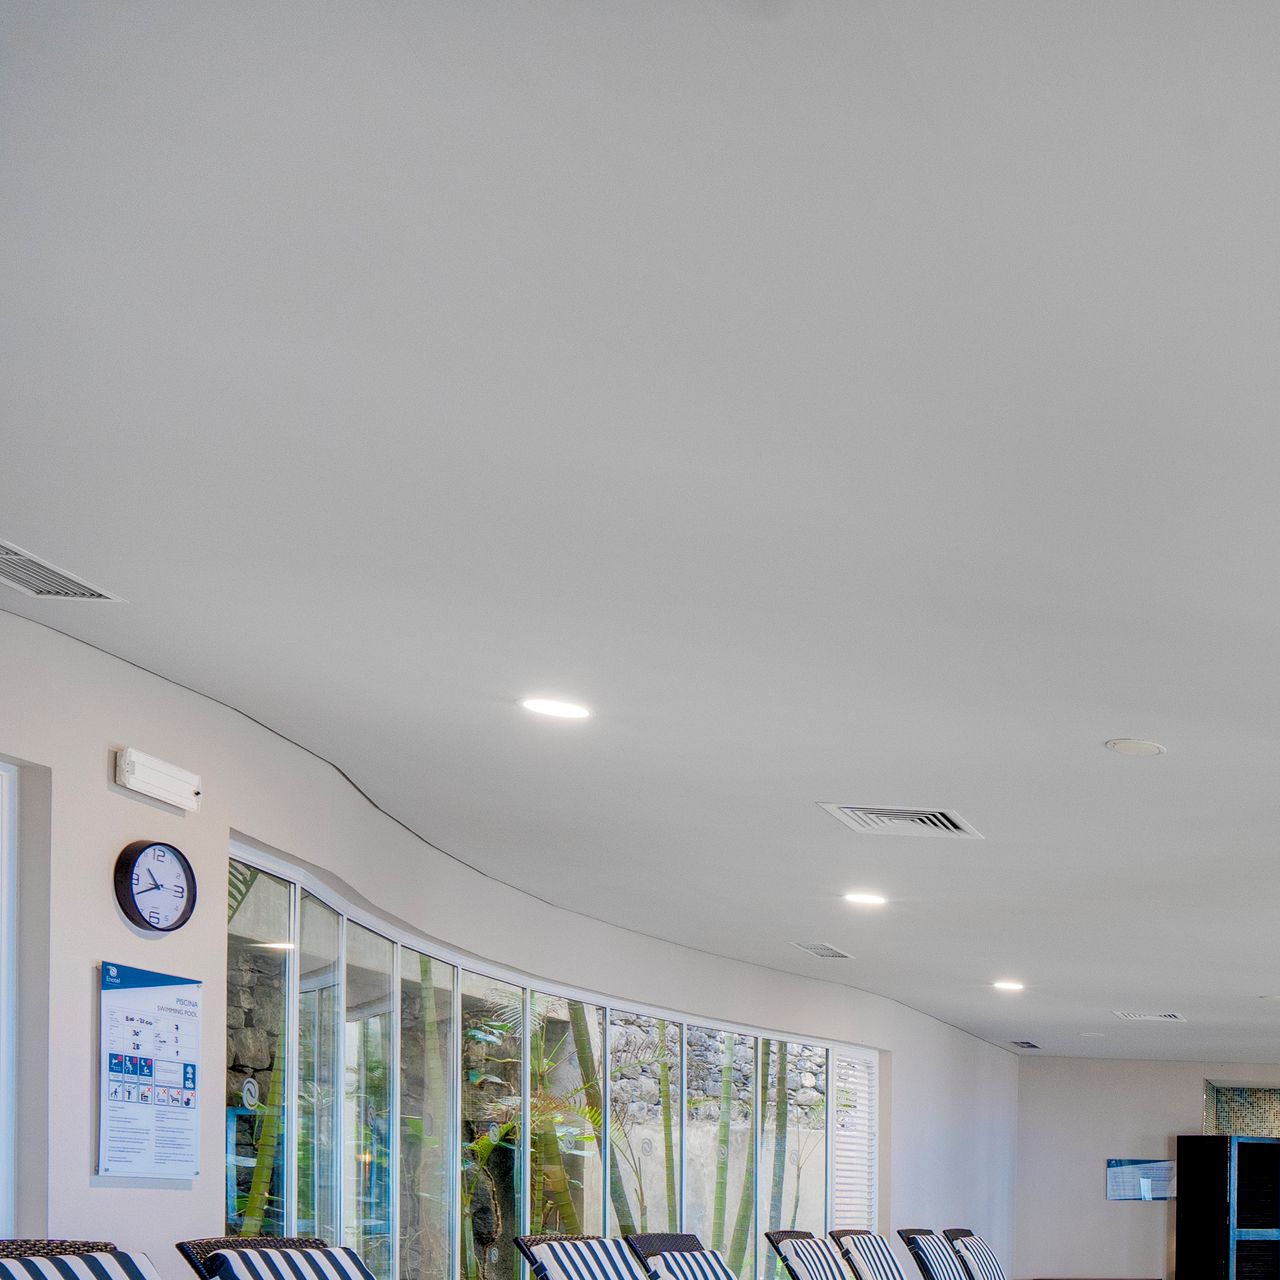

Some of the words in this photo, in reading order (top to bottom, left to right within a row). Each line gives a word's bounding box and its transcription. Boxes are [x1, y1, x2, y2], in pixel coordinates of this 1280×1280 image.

[153, 848, 165, 862] 12
[173, 884, 185, 898] 3
[148, 910, 160, 924] 6
[176, 998, 198, 1008] PISCINA
[157, 1006, 183, 1015] SWIMMING
